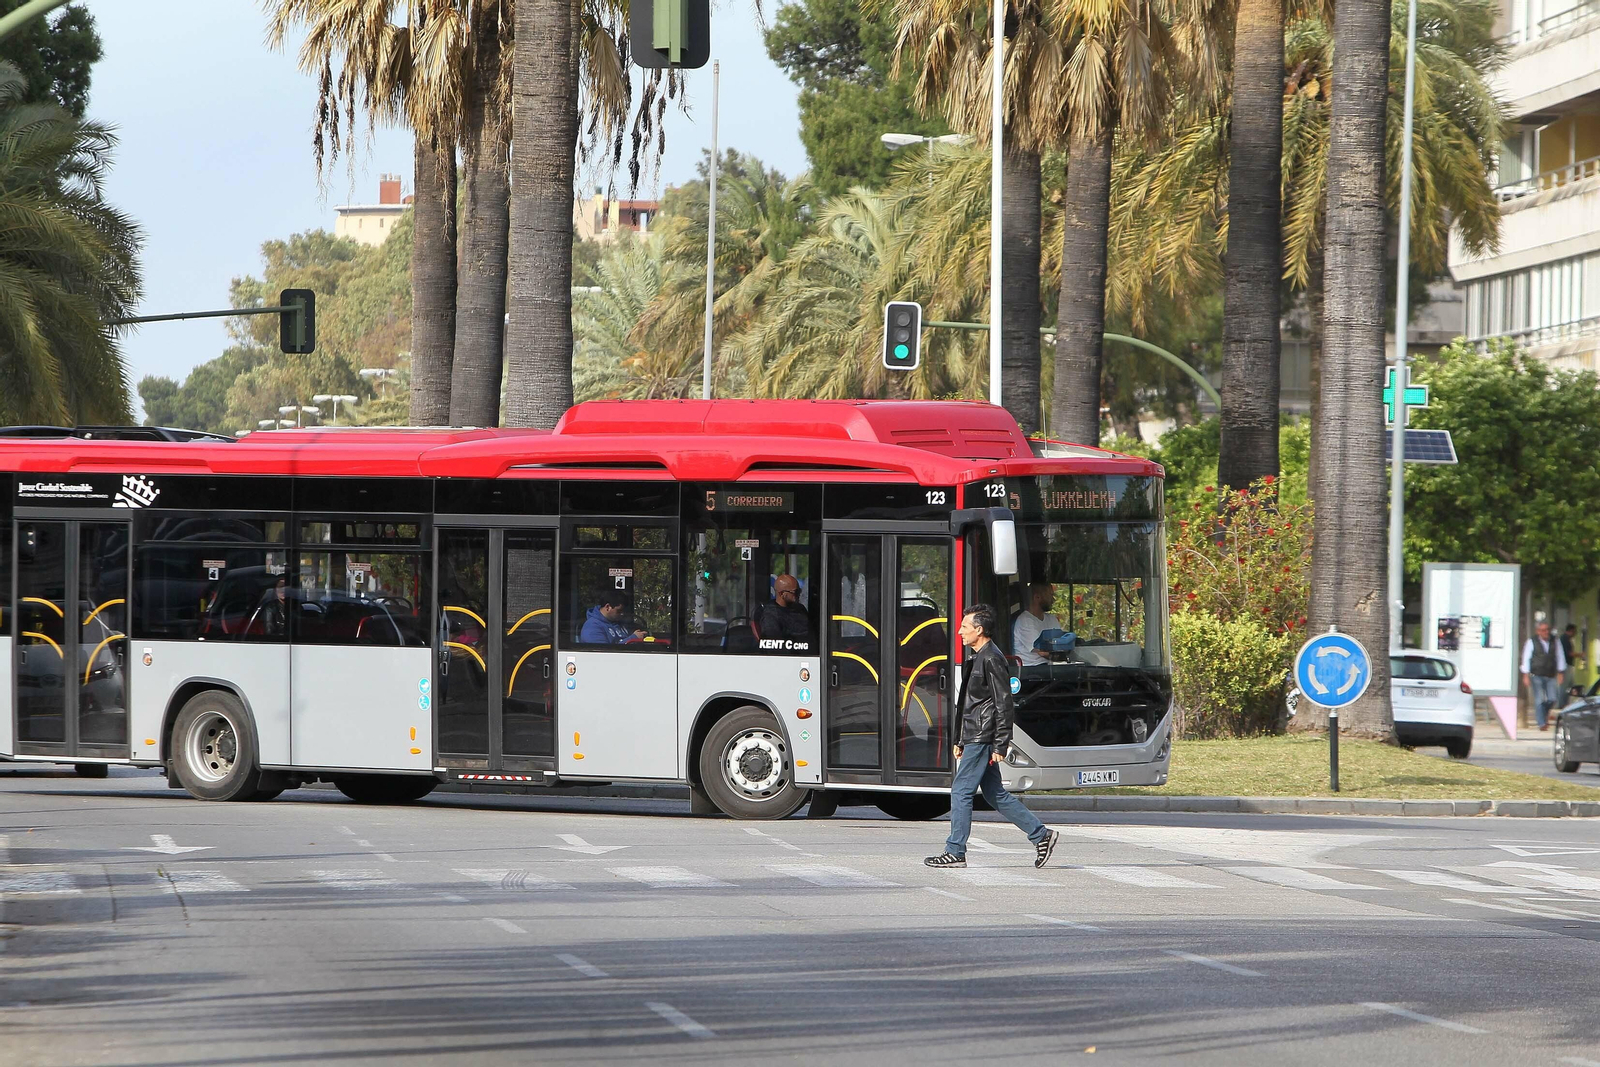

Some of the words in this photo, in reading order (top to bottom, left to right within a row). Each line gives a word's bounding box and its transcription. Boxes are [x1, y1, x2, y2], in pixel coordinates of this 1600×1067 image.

[925, 491, 946, 505] 123
[983, 484, 1006, 498] 123
[705, 490, 716, 511] 5
[727, 496, 783, 506] CORREDERA
[1009, 491, 1021, 510] 5
[759, 640, 784, 649] KENT
[785, 640, 793, 649] C
[793, 642, 809, 650] CNG
[1082, 697, 1112, 707] OTOKAR
[1082, 772, 1102, 783] 2445
